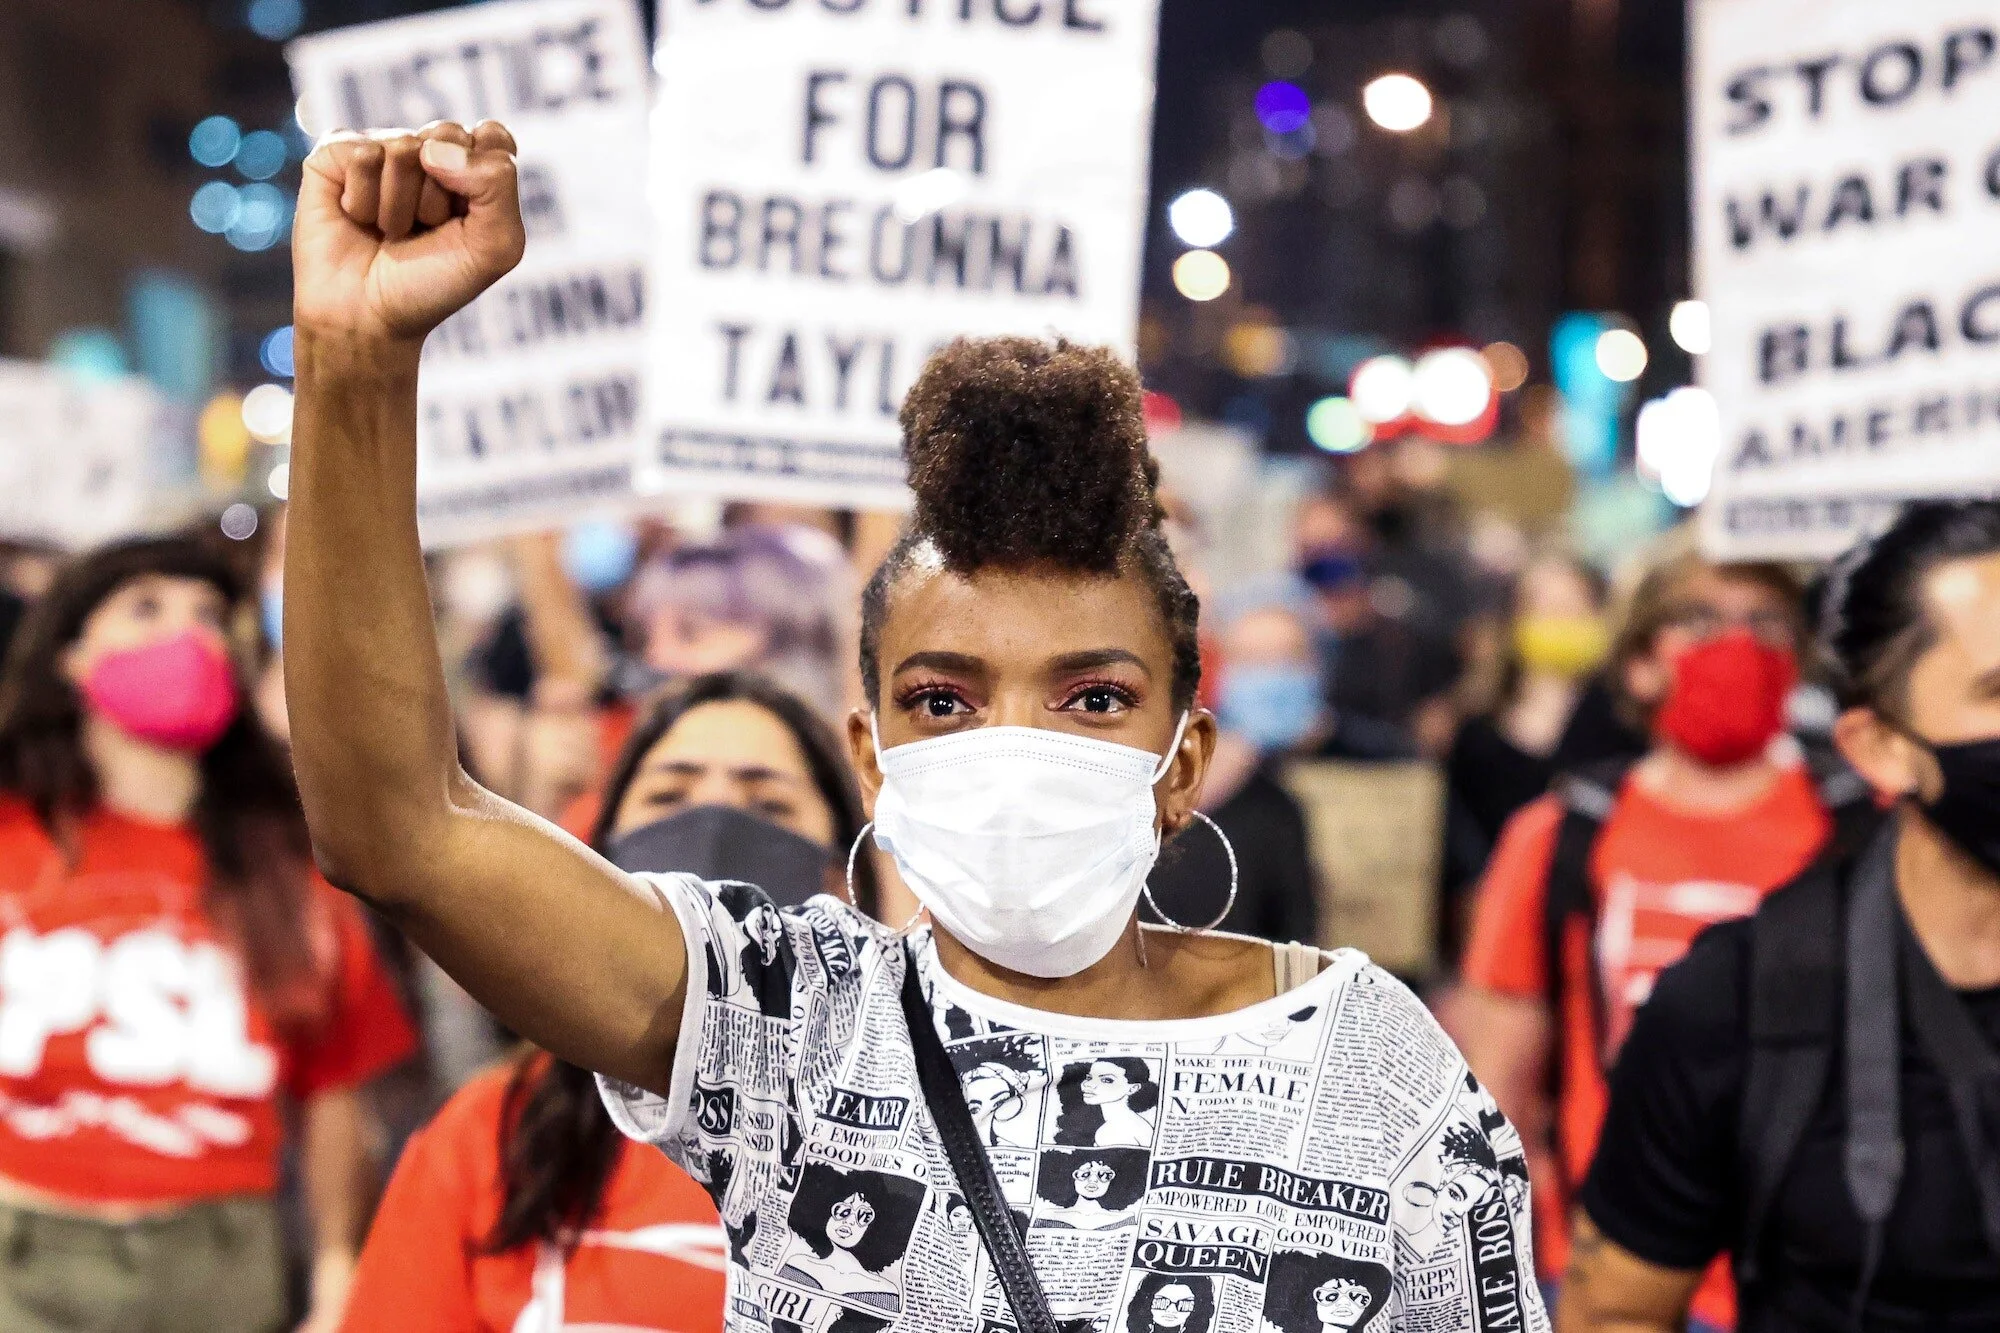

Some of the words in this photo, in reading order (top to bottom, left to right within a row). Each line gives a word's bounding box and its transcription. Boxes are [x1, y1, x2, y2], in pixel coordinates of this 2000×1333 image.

[1724, 27, 1996, 136] STOP
[800, 70, 986, 176] FOR
[1725, 157, 1945, 250] WAR
[700, 190, 1077, 298] BREONNA
[717, 322, 905, 418] TAYL
[1731, 390, 2000, 470] AMERI
[0, 922, 281, 1100] PSL
[1174, 1058, 1215, 1068] MAKE
[1222, 1058, 1252, 1068] THE
[1259, 1060, 1313, 1076] FUTURE
[1173, 1072, 1309, 1102] FEMALE
[1198, 1096, 1236, 1106] TODAY
[1243, 1097, 1253, 1106] IS
[1259, 1099, 1279, 1111] THE
[1283, 1105, 1305, 1116] DAY
[808, 1141, 866, 1166] GOOD
[1156, 1160, 1245, 1190] RULE
[1258, 1167, 1390, 1220] BREAKER
[833, 1205, 872, 1223] LOVE
[1146, 1191, 1247, 1213] EMPOWERED
[1256, 1201, 1288, 1223] LOVE
[1295, 1212, 1386, 1244] EMPOWERED
[1473, 1185, 1513, 1265] BOSS
[1145, 1218, 1269, 1250] SAVAGE
[1277, 1228, 1333, 1248] GOOD
[1136, 1241, 1268, 1277] QUEEN
[1405, 1265, 1458, 1288] HAPPY
[758, 1283, 817, 1326] GIRL
[1151, 1299, 1171, 1311] SHOP
[1178, 1299, 1195, 1312] PING
[1316, 1291, 1370, 1307] LOVE
[1408, 1280, 1458, 1302] HAPPY
[1481, 1270, 1521, 1333] ALE
